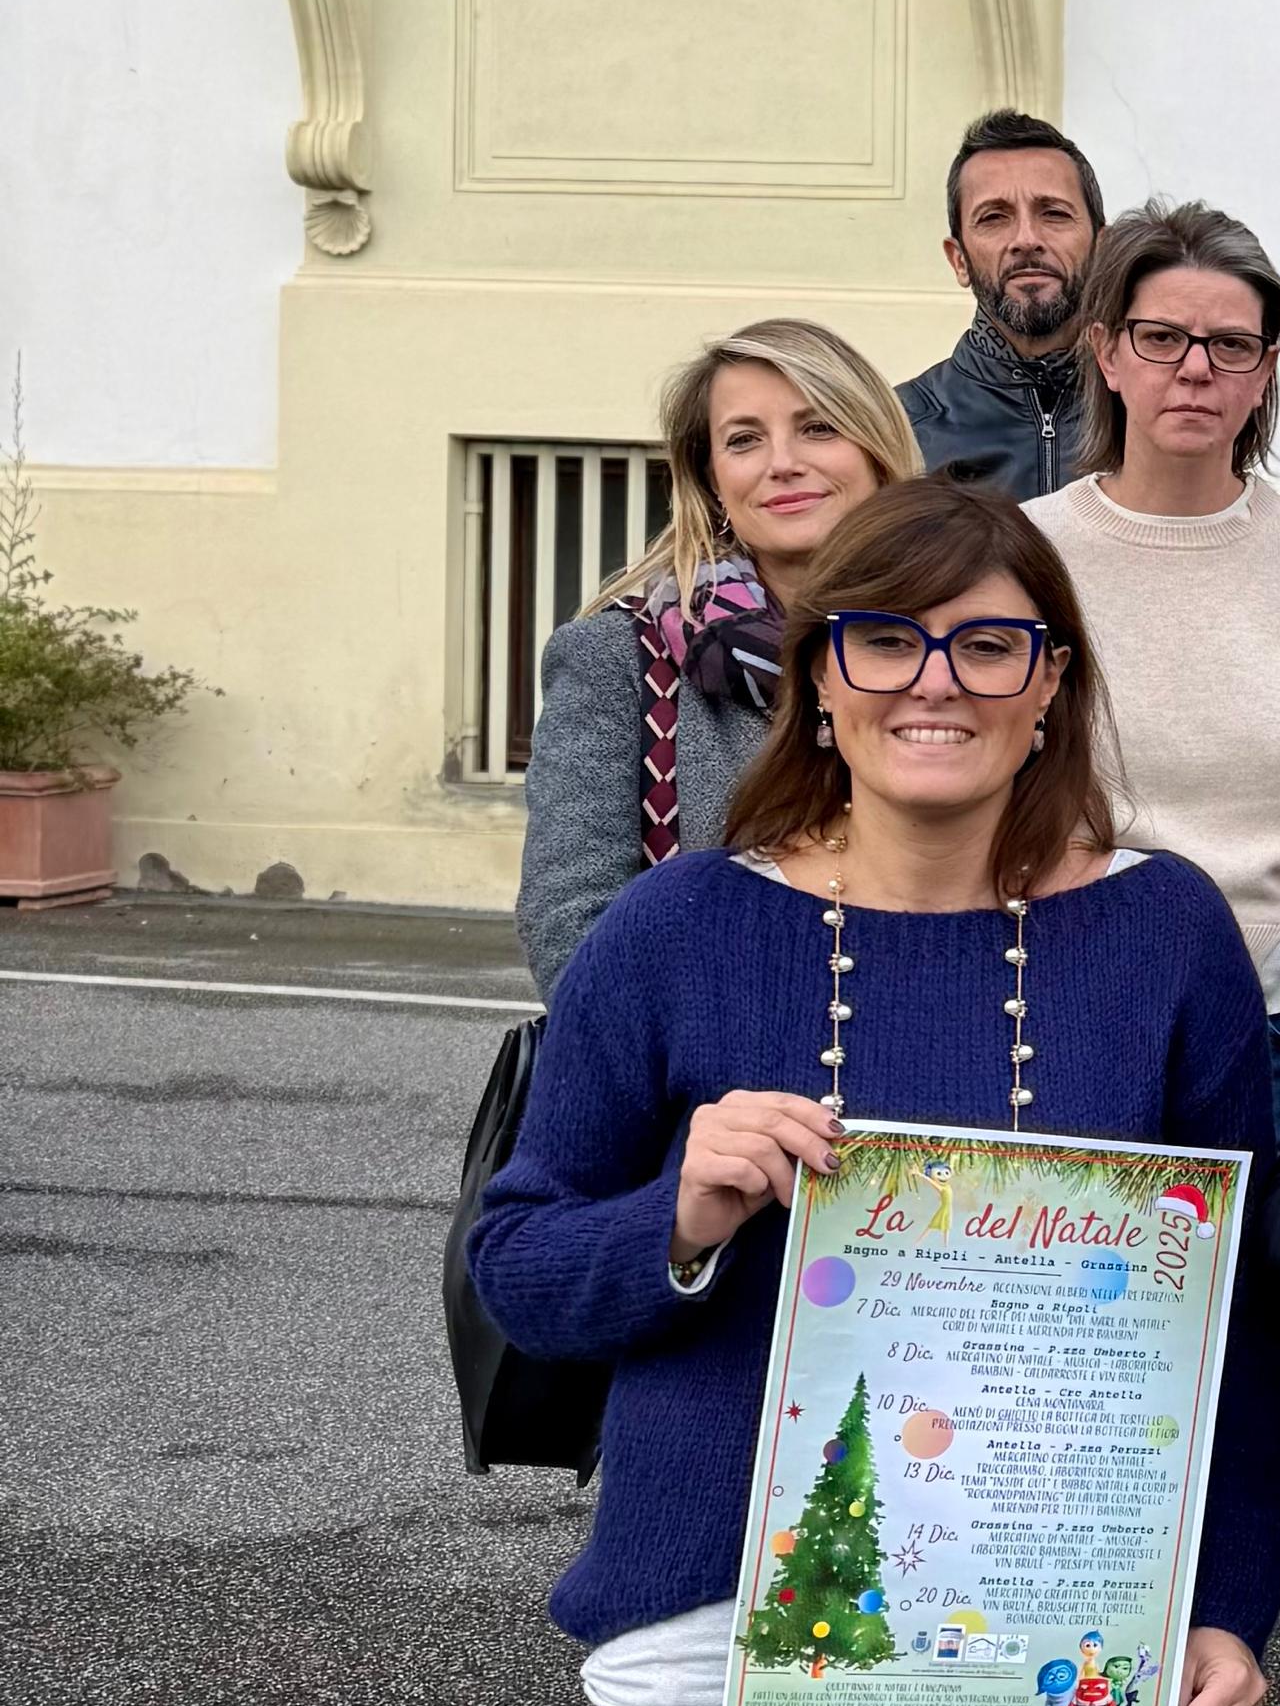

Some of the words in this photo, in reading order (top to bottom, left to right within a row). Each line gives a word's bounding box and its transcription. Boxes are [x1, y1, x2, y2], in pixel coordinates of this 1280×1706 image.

[856, 1192, 914, 1239] La
[965, 1204, 1024, 1239] del
[1029, 1207, 1148, 1250] Natale
[843, 1244, 889, 1258] Bagno
[898, 1249, 906, 1257] a
[915, 1248, 967, 1263] Ripoli
[994, 1254, 1055, 1267] Antella
[1081, 1260, 1148, 1273] Grassina
[1153, 1211, 1194, 1291] 2025
[880, 1270, 902, 1287] 29
[905, 1272, 986, 1293] Novembre
[856, 1298, 868, 1314] 7
[870, 1298, 901, 1319] Dic.
[990, 1299, 1030, 1311] Bagno
[1052, 1303, 1097, 1314] Ripoli
[887, 1341, 900, 1359] 8
[903, 1342, 933, 1363] Dic.
[962, 1340, 1025, 1352] Grassina
[1093, 1348, 1147, 1359] Umberto
[981, 1384, 1036, 1395] Antella
[1059, 1388, 1082, 1398] Crc
[1089, 1389, 1142, 1400] Antella
[877, 1393, 895, 1410] 10
[898, 1394, 931, 1415] Dic.
[986, 1439, 1041, 1450] Antella
[1110, 1445, 1161, 1456] Peruzzi
[903, 1462, 922, 1479] 13
[925, 1462, 955, 1483] Dic.
[907, 1523, 925, 1540] 14
[928, 1524, 958, 1544] Dic.
[971, 1520, 1033, 1531] Grassina
[1102, 1524, 1154, 1535] Umberto
[978, 1576, 1034, 1587] Antella
[1102, 1579, 1154, 1590] Peruzzi
[915, 1587, 938, 1604] 20
[942, 1588, 972, 1607] Dic.
